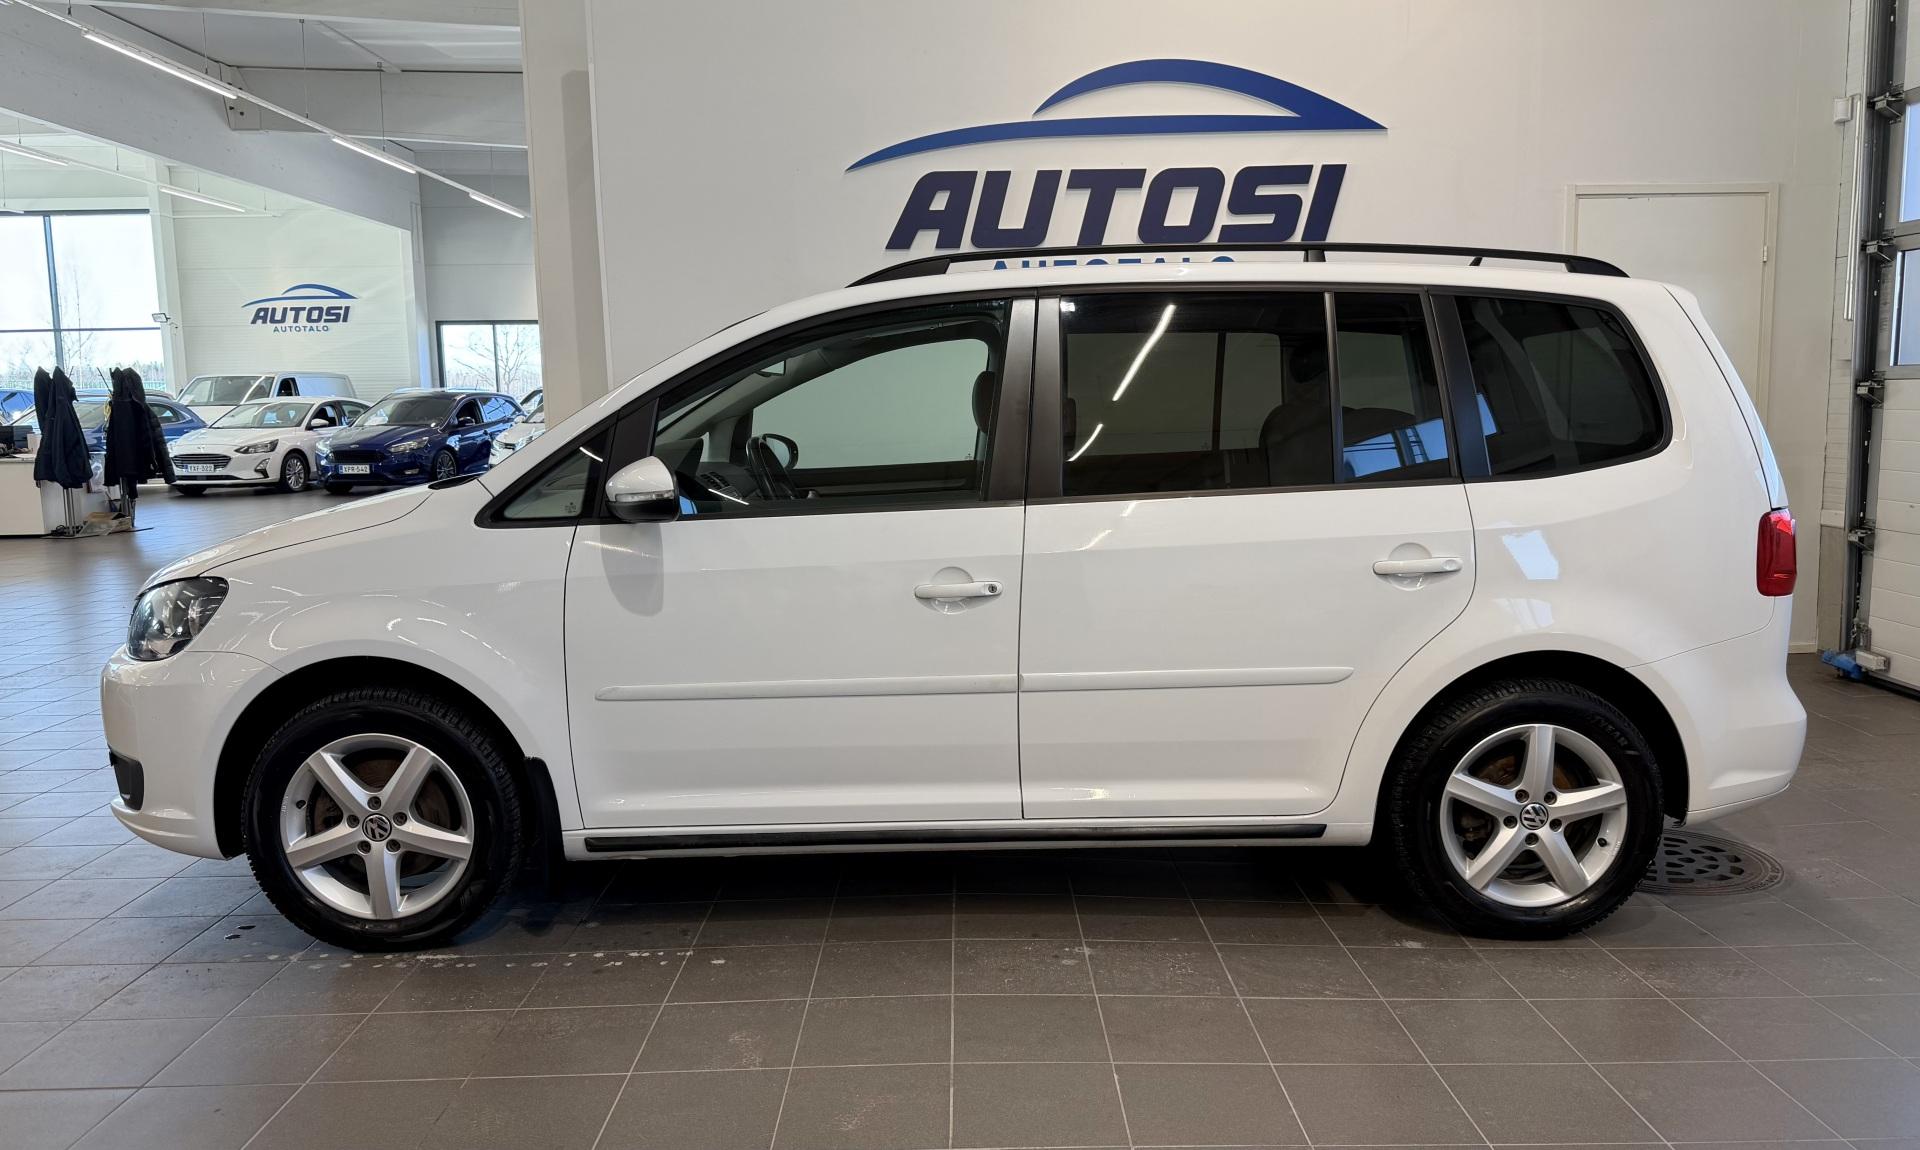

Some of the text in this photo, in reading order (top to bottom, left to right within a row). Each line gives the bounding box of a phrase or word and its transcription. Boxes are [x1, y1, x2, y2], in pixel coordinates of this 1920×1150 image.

[885, 163, 1348, 250] AUTOSI
[250, 305, 351, 325] AUTOSI
[273, 325, 329, 333] AUTOTALO
